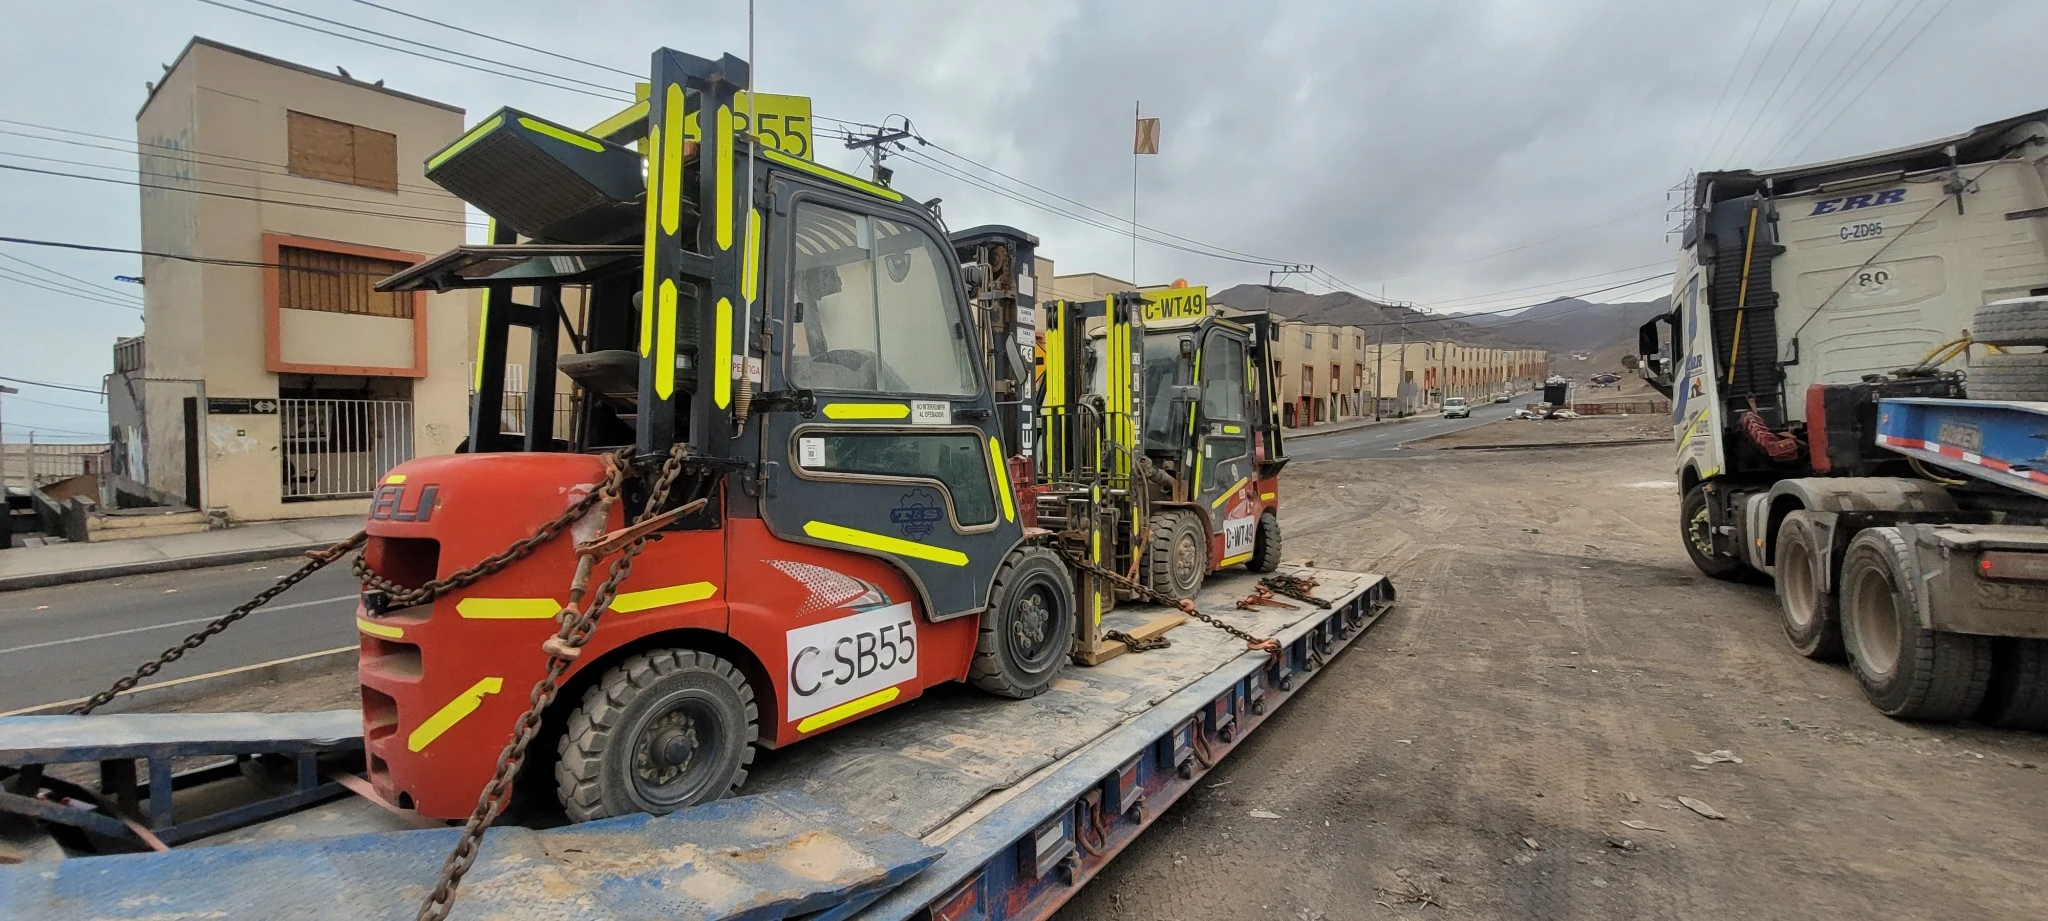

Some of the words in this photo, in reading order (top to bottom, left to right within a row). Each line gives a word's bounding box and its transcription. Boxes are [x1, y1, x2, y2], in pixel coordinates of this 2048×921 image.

[1808, 189, 1907, 216] ERR
[1840, 222, 1883, 240] C-ZD95
[1145, 294, 1202, 320] C-WT49
[895, 509, 939, 520] T&S
[1226, 523, 1253, 549] C-WT49
[790, 620, 915, 697] C-SB55
